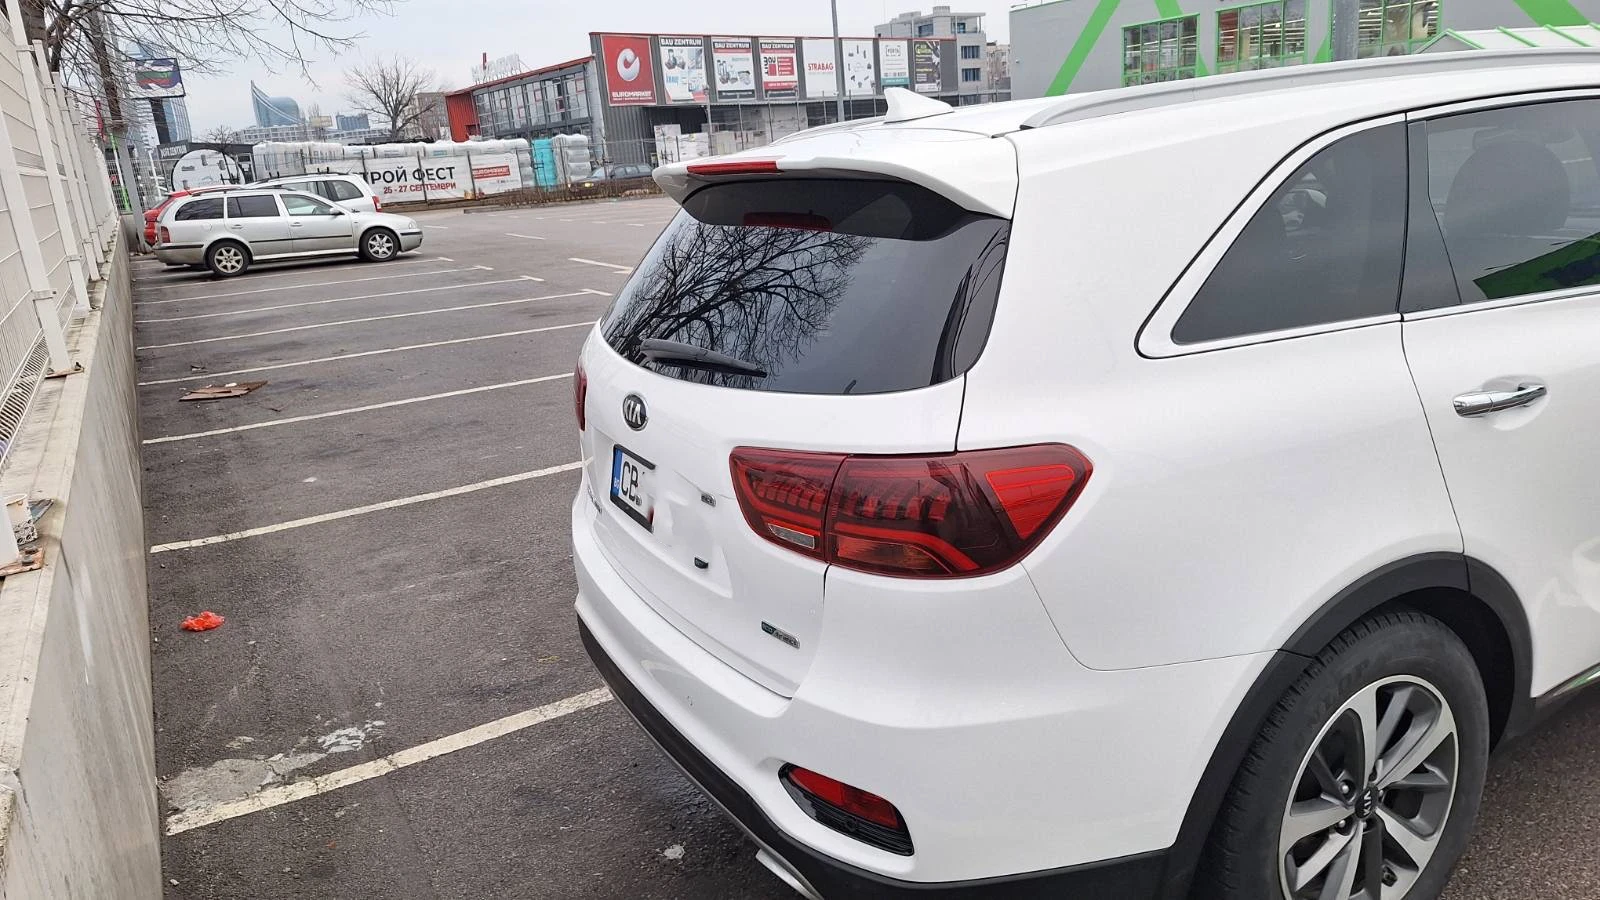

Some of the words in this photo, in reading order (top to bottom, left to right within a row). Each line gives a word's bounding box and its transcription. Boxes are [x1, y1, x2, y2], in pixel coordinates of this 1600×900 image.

[674, 38, 701, 46] ZENTRUM
[808, 63, 833, 71] STRABAG
[353, 166, 408, 185] ТРОЙ
[412, 166, 455, 182] ФЕСТ
[399, 185, 408, 193] 27
[410, 182, 457, 192] СЕПТЕМВРИ
[624, 402, 641, 424] KIA
